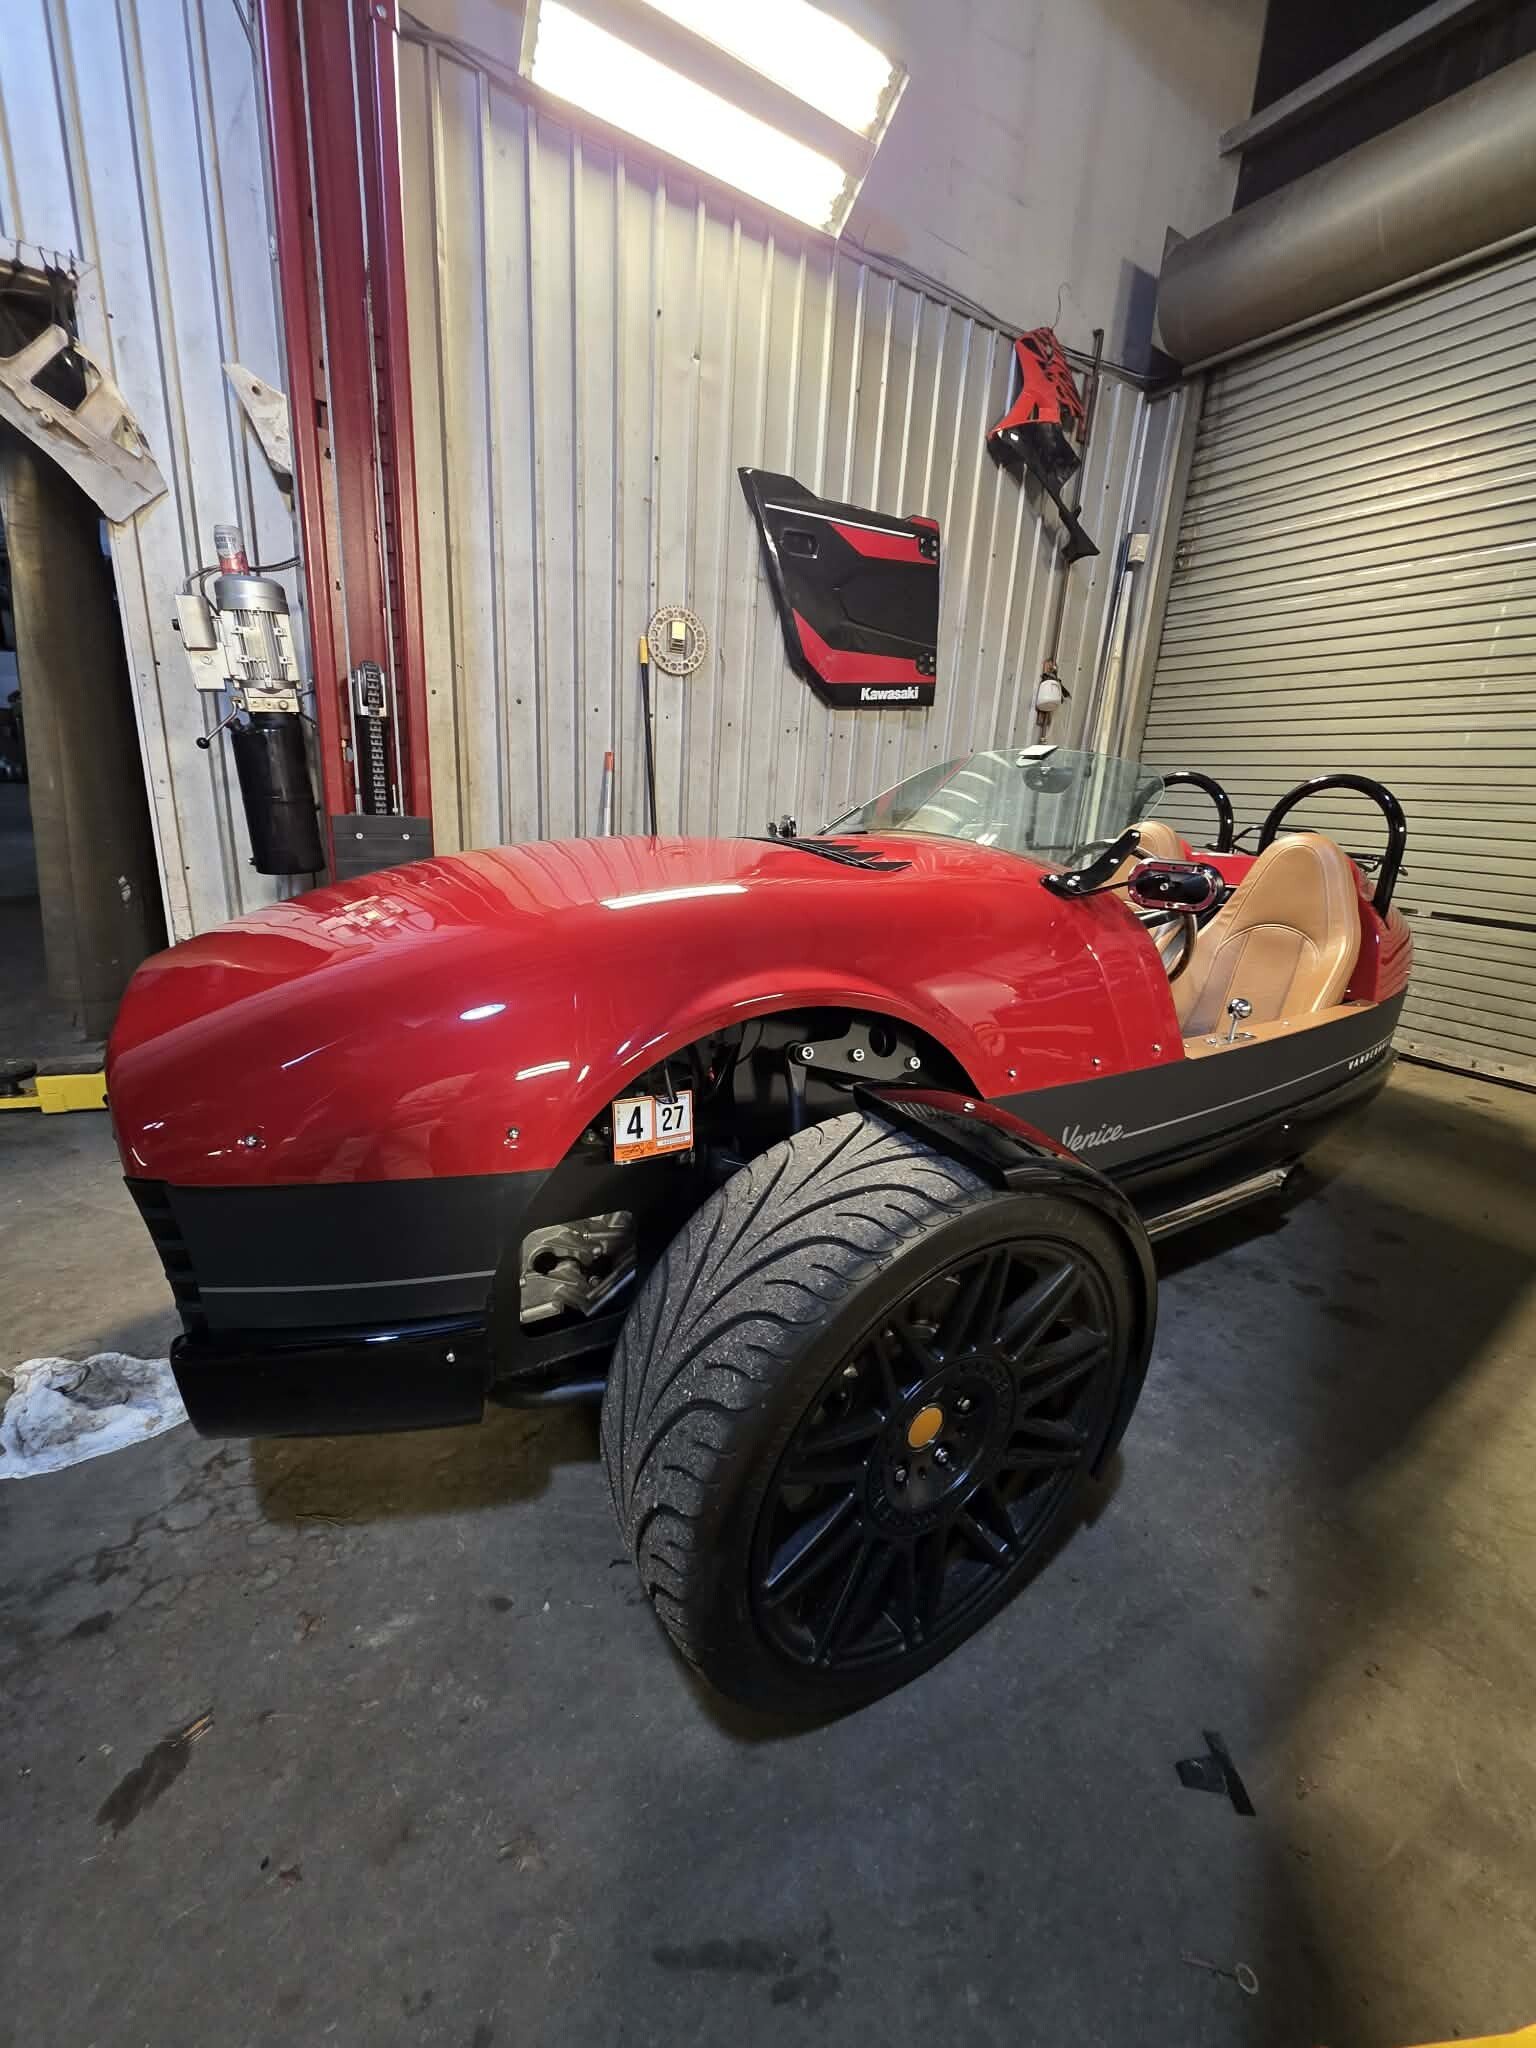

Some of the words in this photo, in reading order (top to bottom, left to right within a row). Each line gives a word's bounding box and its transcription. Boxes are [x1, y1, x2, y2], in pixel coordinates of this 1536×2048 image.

[861, 687, 919, 700] Kawasaki
[627, 1105, 643, 1139] 4
[662, 1105, 684, 1131] 27
[1062, 1124, 1123, 1151] Venice
